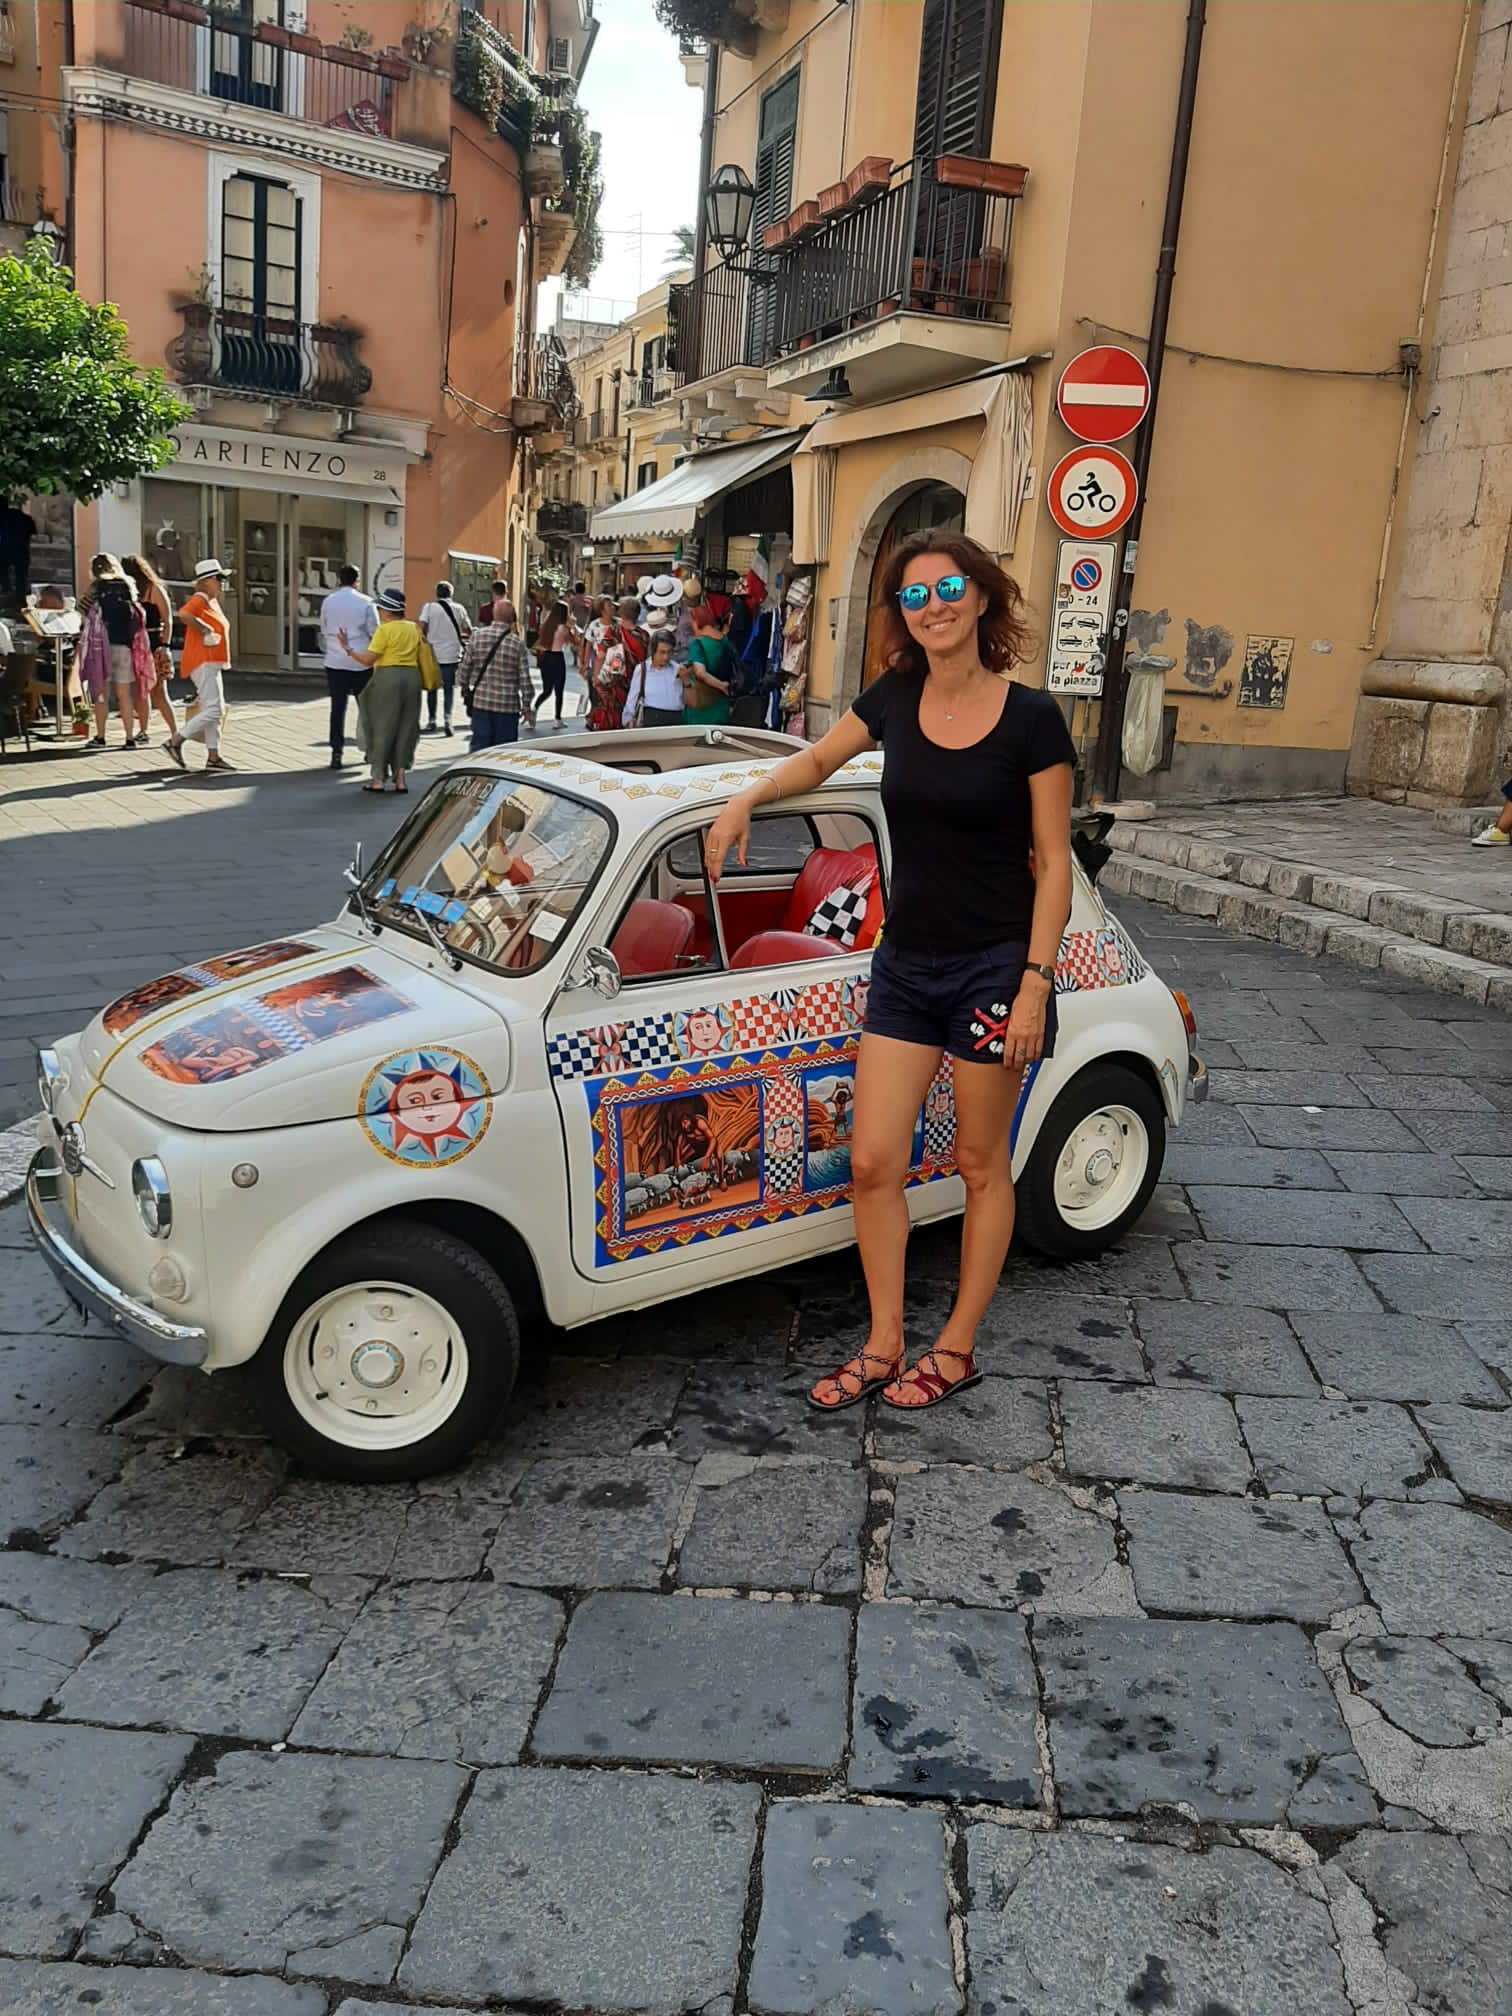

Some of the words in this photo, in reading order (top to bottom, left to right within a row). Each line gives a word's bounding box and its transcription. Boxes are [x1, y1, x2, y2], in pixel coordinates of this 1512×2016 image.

[166, 433, 346, 477] D'ARIENZO
[373, 469, 386, 481] 28
[1086, 594, 1098, 606] 24
[1051, 673, 1061, 685] la
[1063, 674, 1098, 688] piazza
